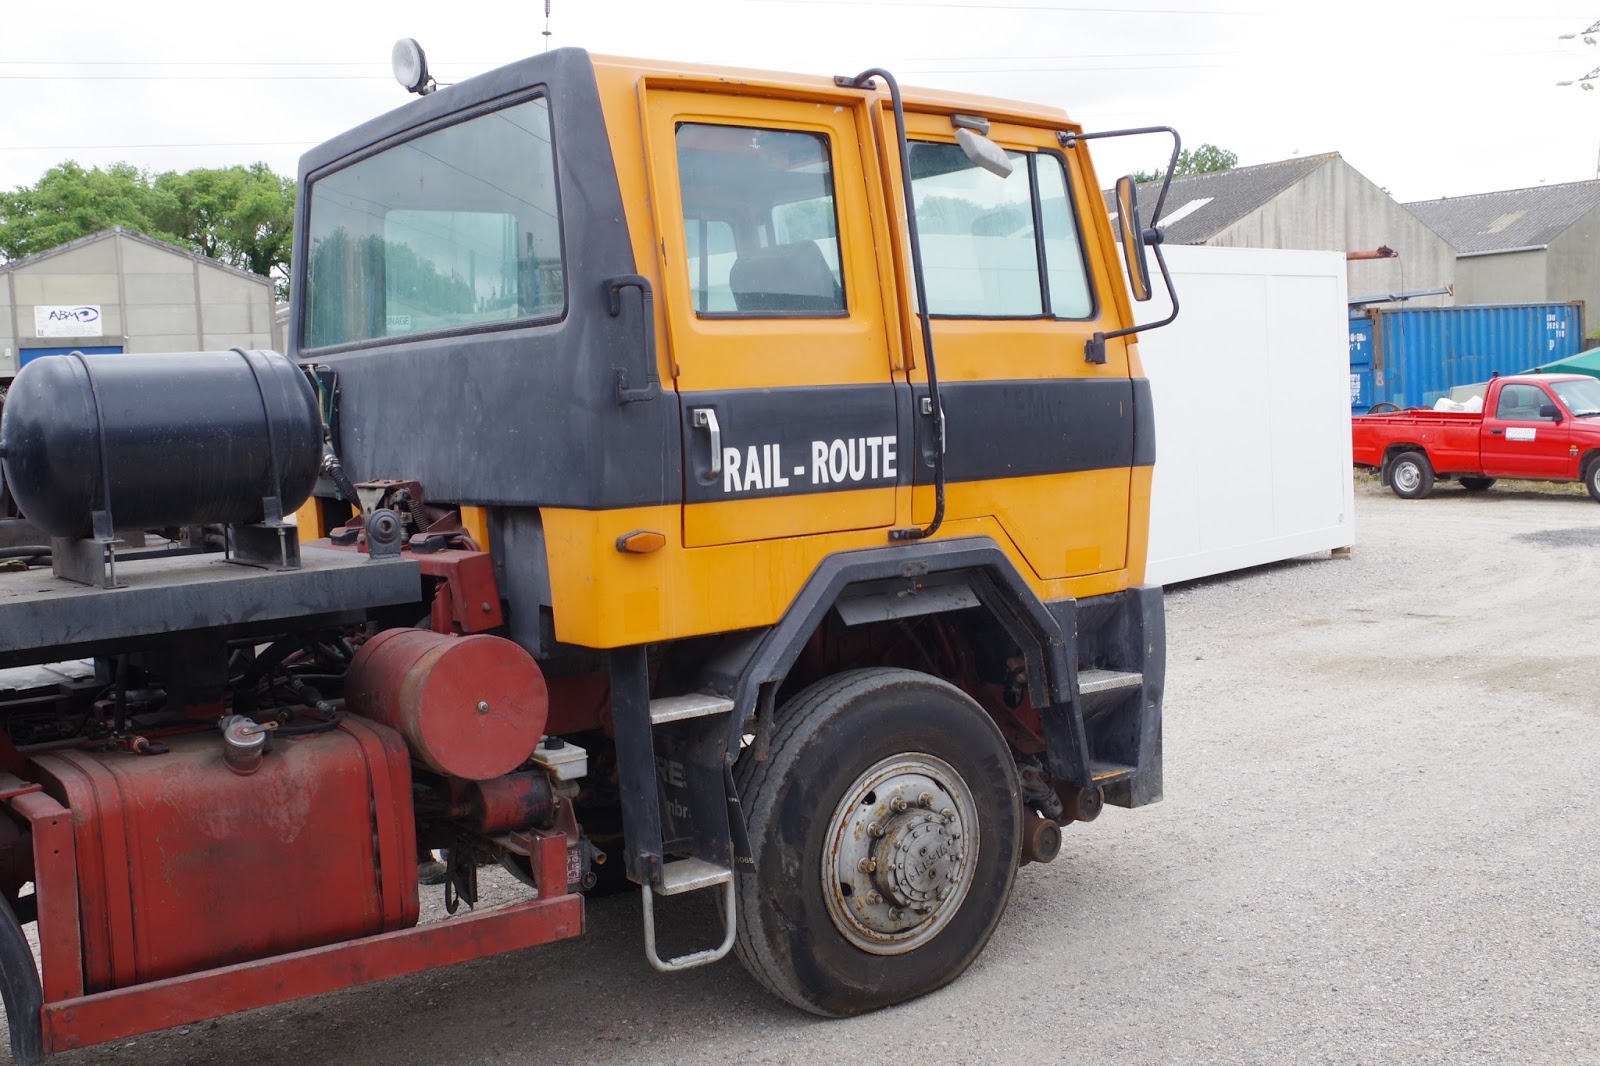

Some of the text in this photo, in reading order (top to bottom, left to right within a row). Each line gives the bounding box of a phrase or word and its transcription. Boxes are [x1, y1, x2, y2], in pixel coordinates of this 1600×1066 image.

[723, 435, 897, 492] RAIL - ROUTE
